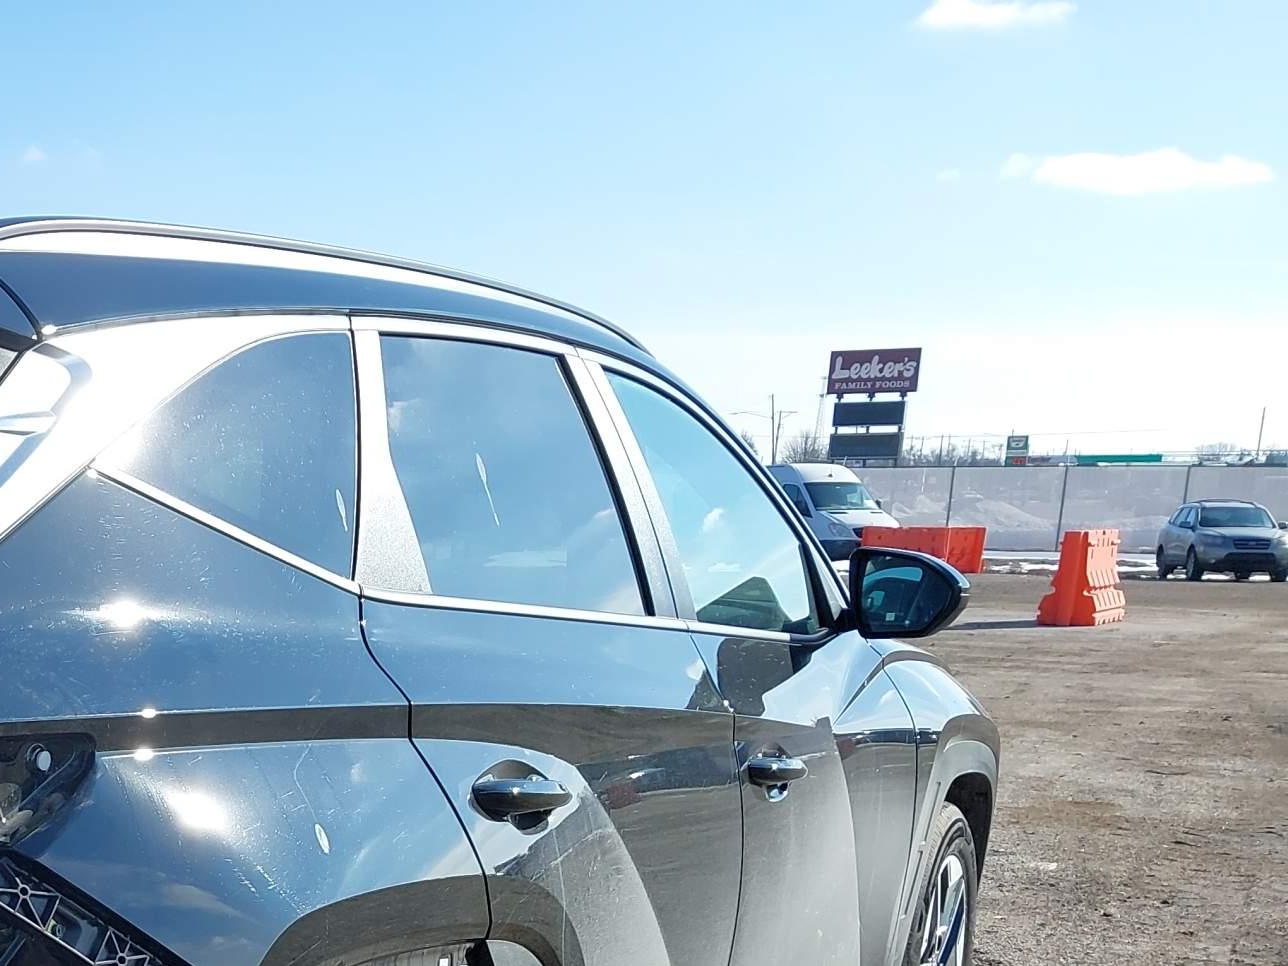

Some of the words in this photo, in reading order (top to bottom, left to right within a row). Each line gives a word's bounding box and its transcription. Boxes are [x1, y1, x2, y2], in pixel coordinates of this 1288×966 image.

[831, 355, 917, 379] Leeker's
[834, 381, 873, 390] FAMILY
[875, 380, 911, 388] FOODS
